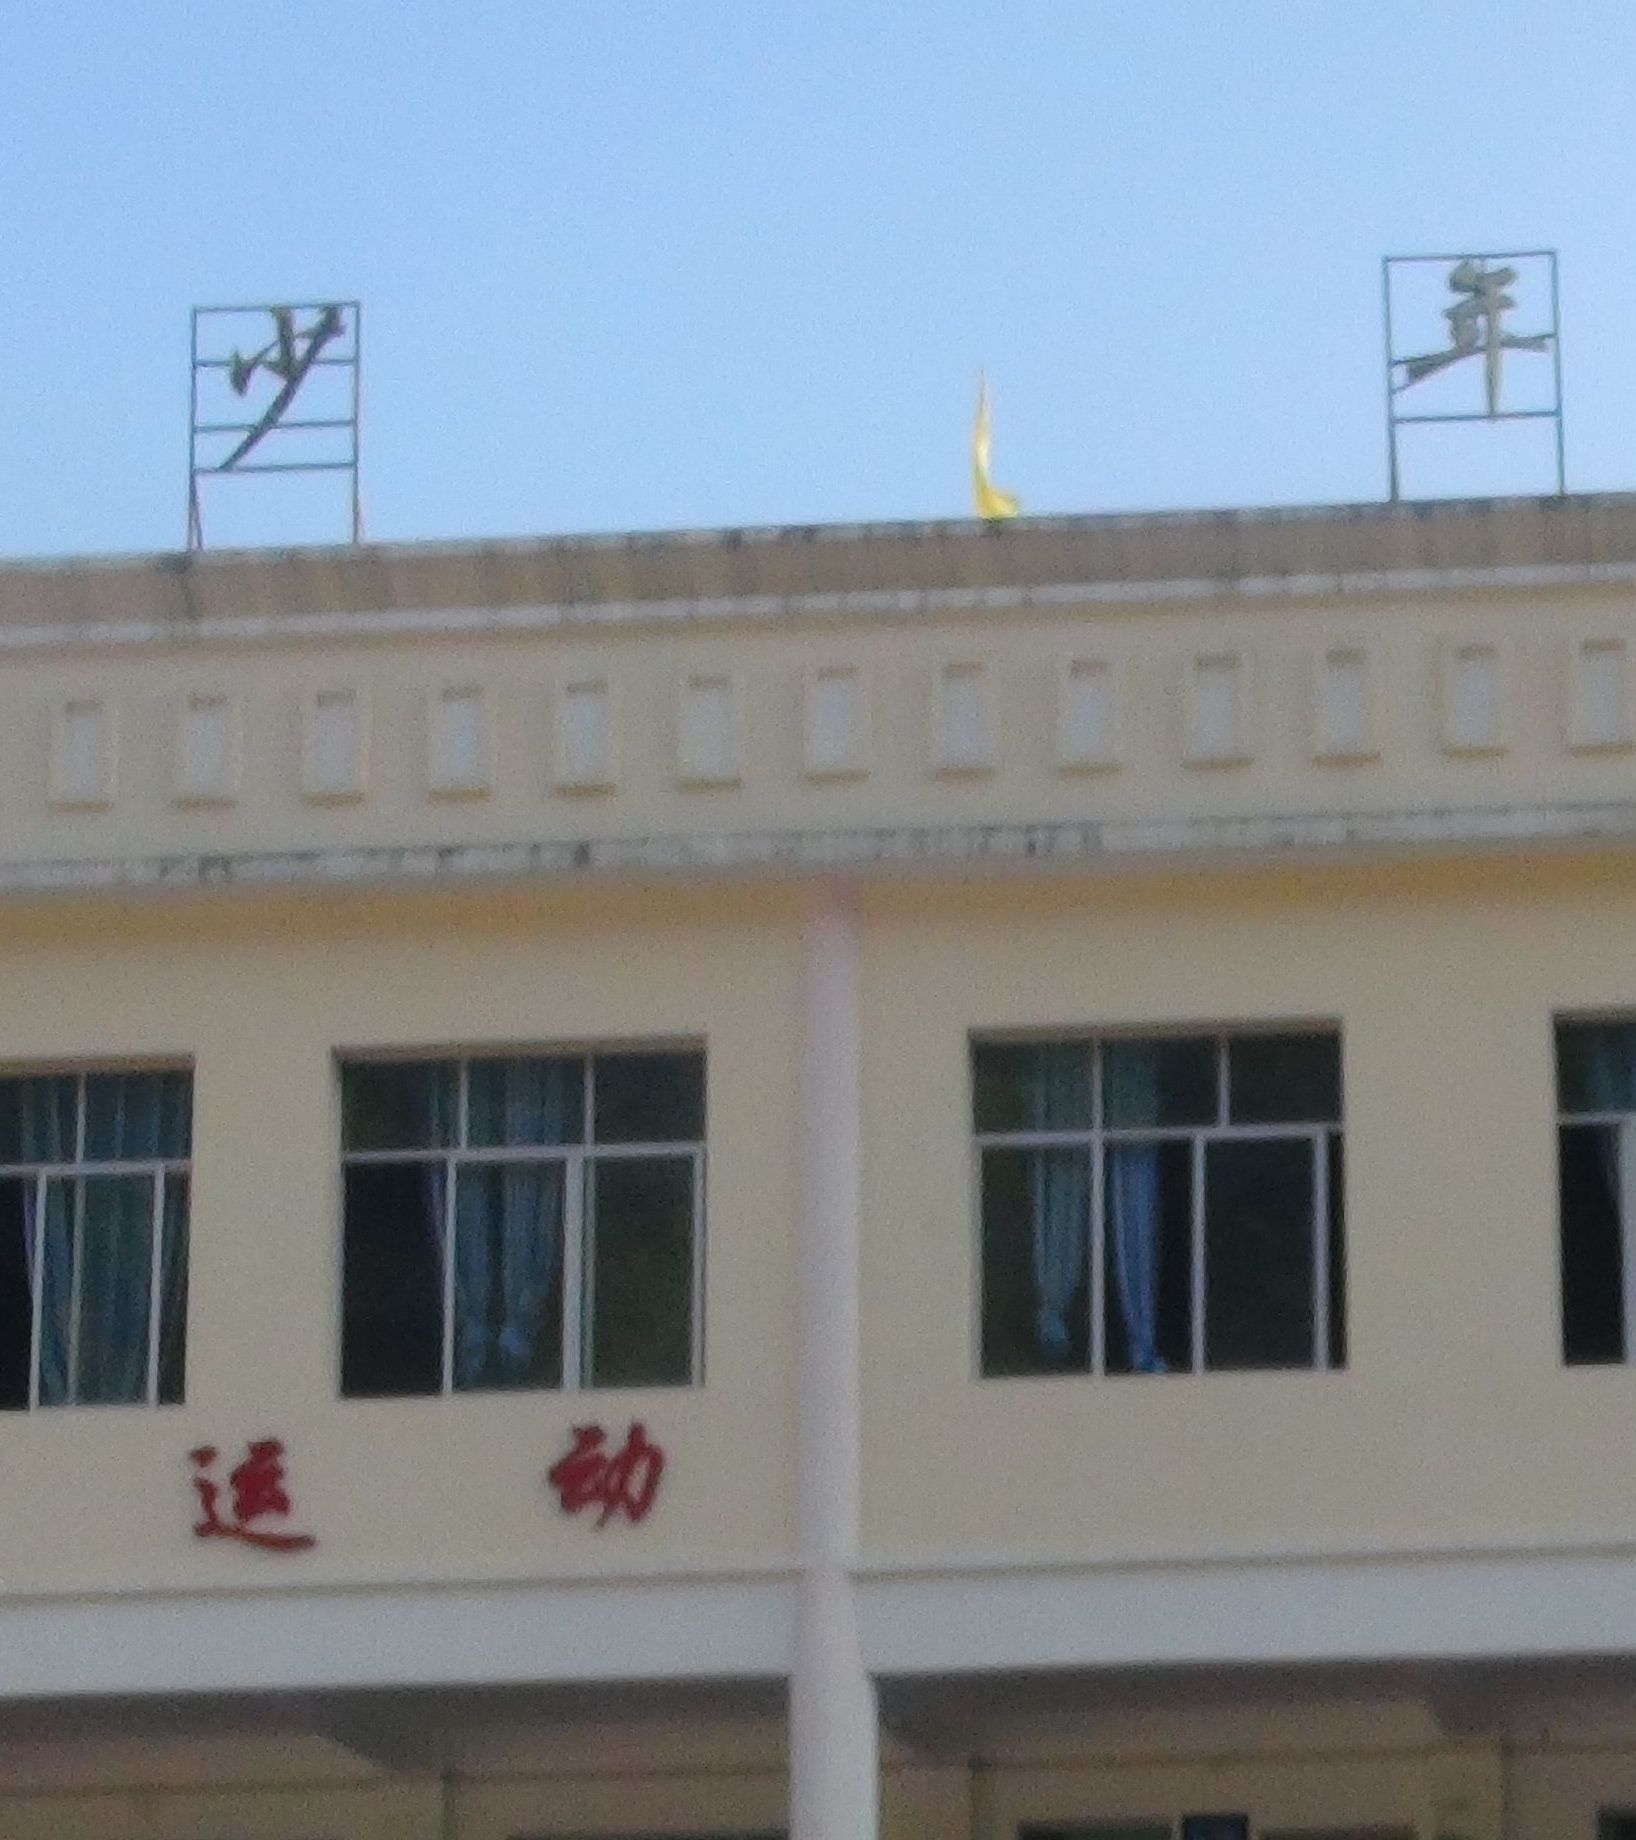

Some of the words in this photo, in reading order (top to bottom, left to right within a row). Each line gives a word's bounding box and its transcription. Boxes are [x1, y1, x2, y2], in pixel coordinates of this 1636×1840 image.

[215, 304, 346, 471] 少
[1406, 257, 1548, 415] 年
[190, 1438, 317, 1553] 运
[549, 1420, 666, 1530] 动
